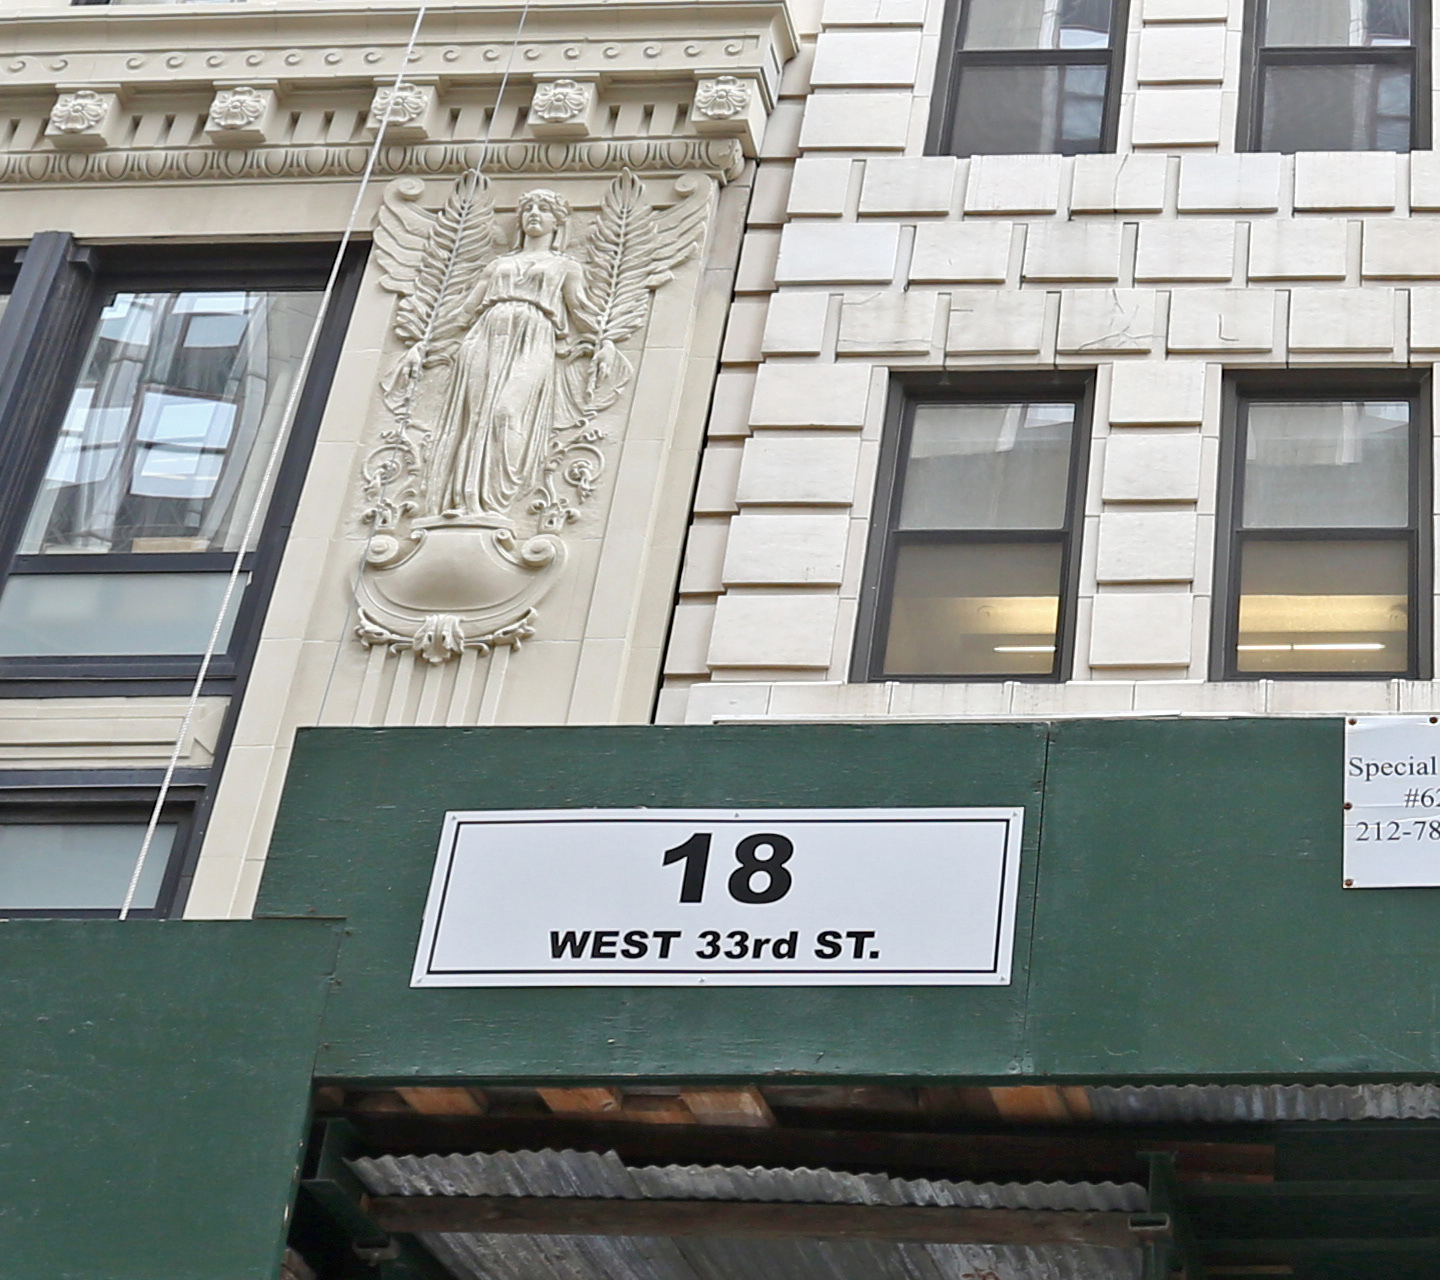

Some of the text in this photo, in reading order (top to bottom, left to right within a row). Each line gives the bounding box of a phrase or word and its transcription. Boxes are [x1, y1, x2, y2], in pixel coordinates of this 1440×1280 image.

[1348, 755, 1437, 782] Special
[661, 832, 795, 905] 18
[548, 930, 881, 960] WEST 33rd ST.
